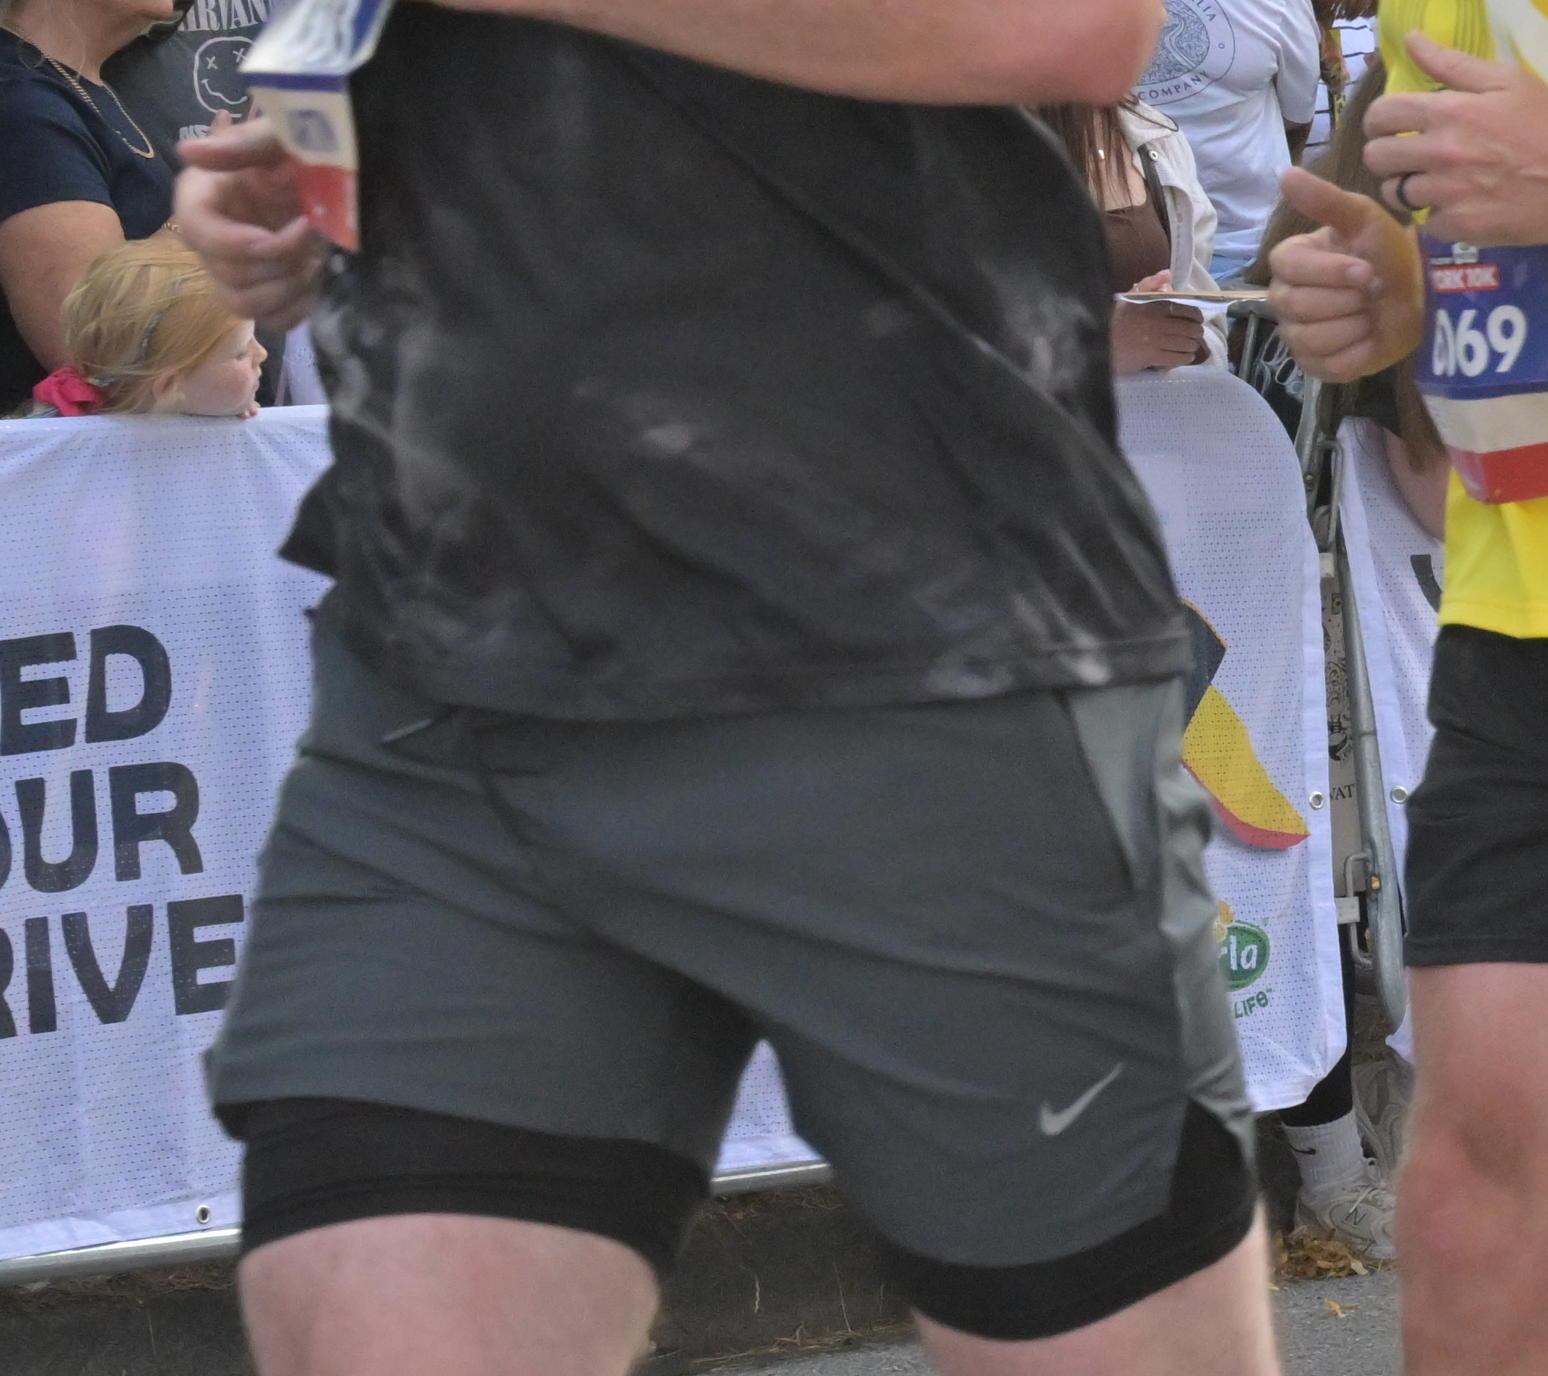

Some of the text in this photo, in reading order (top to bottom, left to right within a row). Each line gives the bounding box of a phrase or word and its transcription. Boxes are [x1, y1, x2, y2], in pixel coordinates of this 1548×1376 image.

[1138, 70, 1209, 100] COMPANY
[0, 762, 203, 893] UR
[0, 894, 244, 1039] IVE
